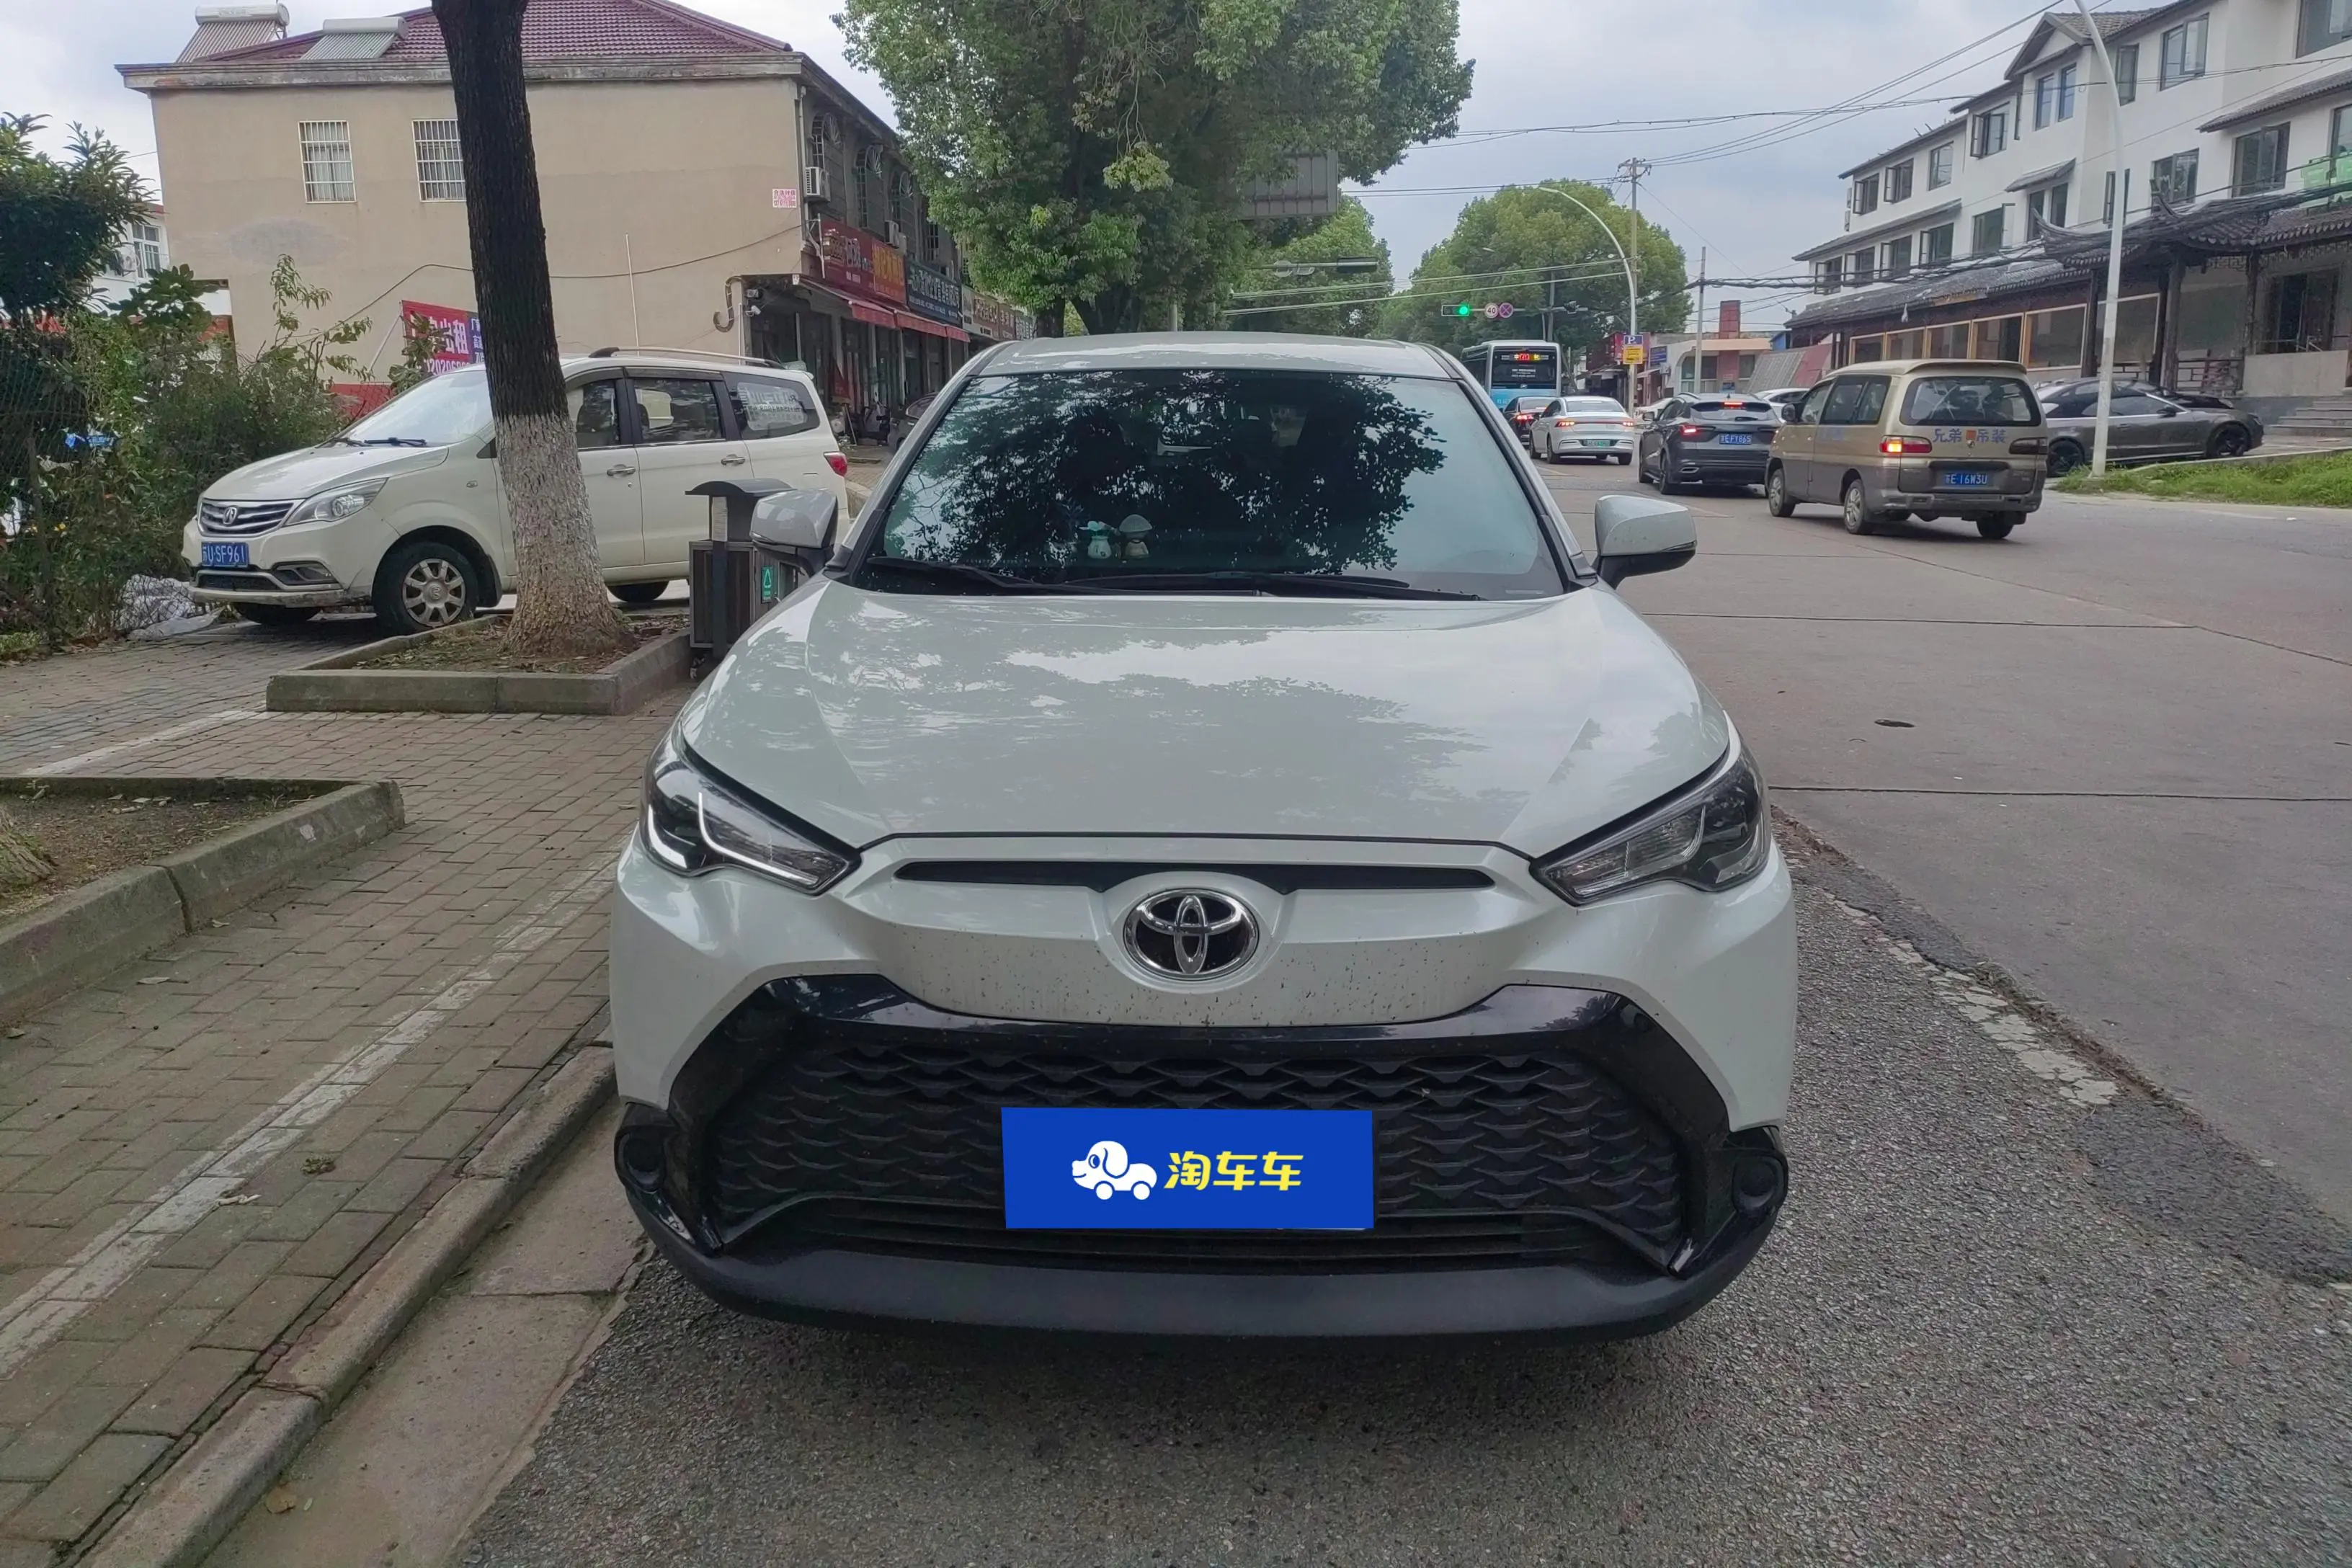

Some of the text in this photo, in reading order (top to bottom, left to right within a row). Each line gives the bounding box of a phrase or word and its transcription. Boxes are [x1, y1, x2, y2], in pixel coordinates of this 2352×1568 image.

[1627, 336, 1636, 344] P
[1933, 429, 2007, 443] 兄弟 吊装
